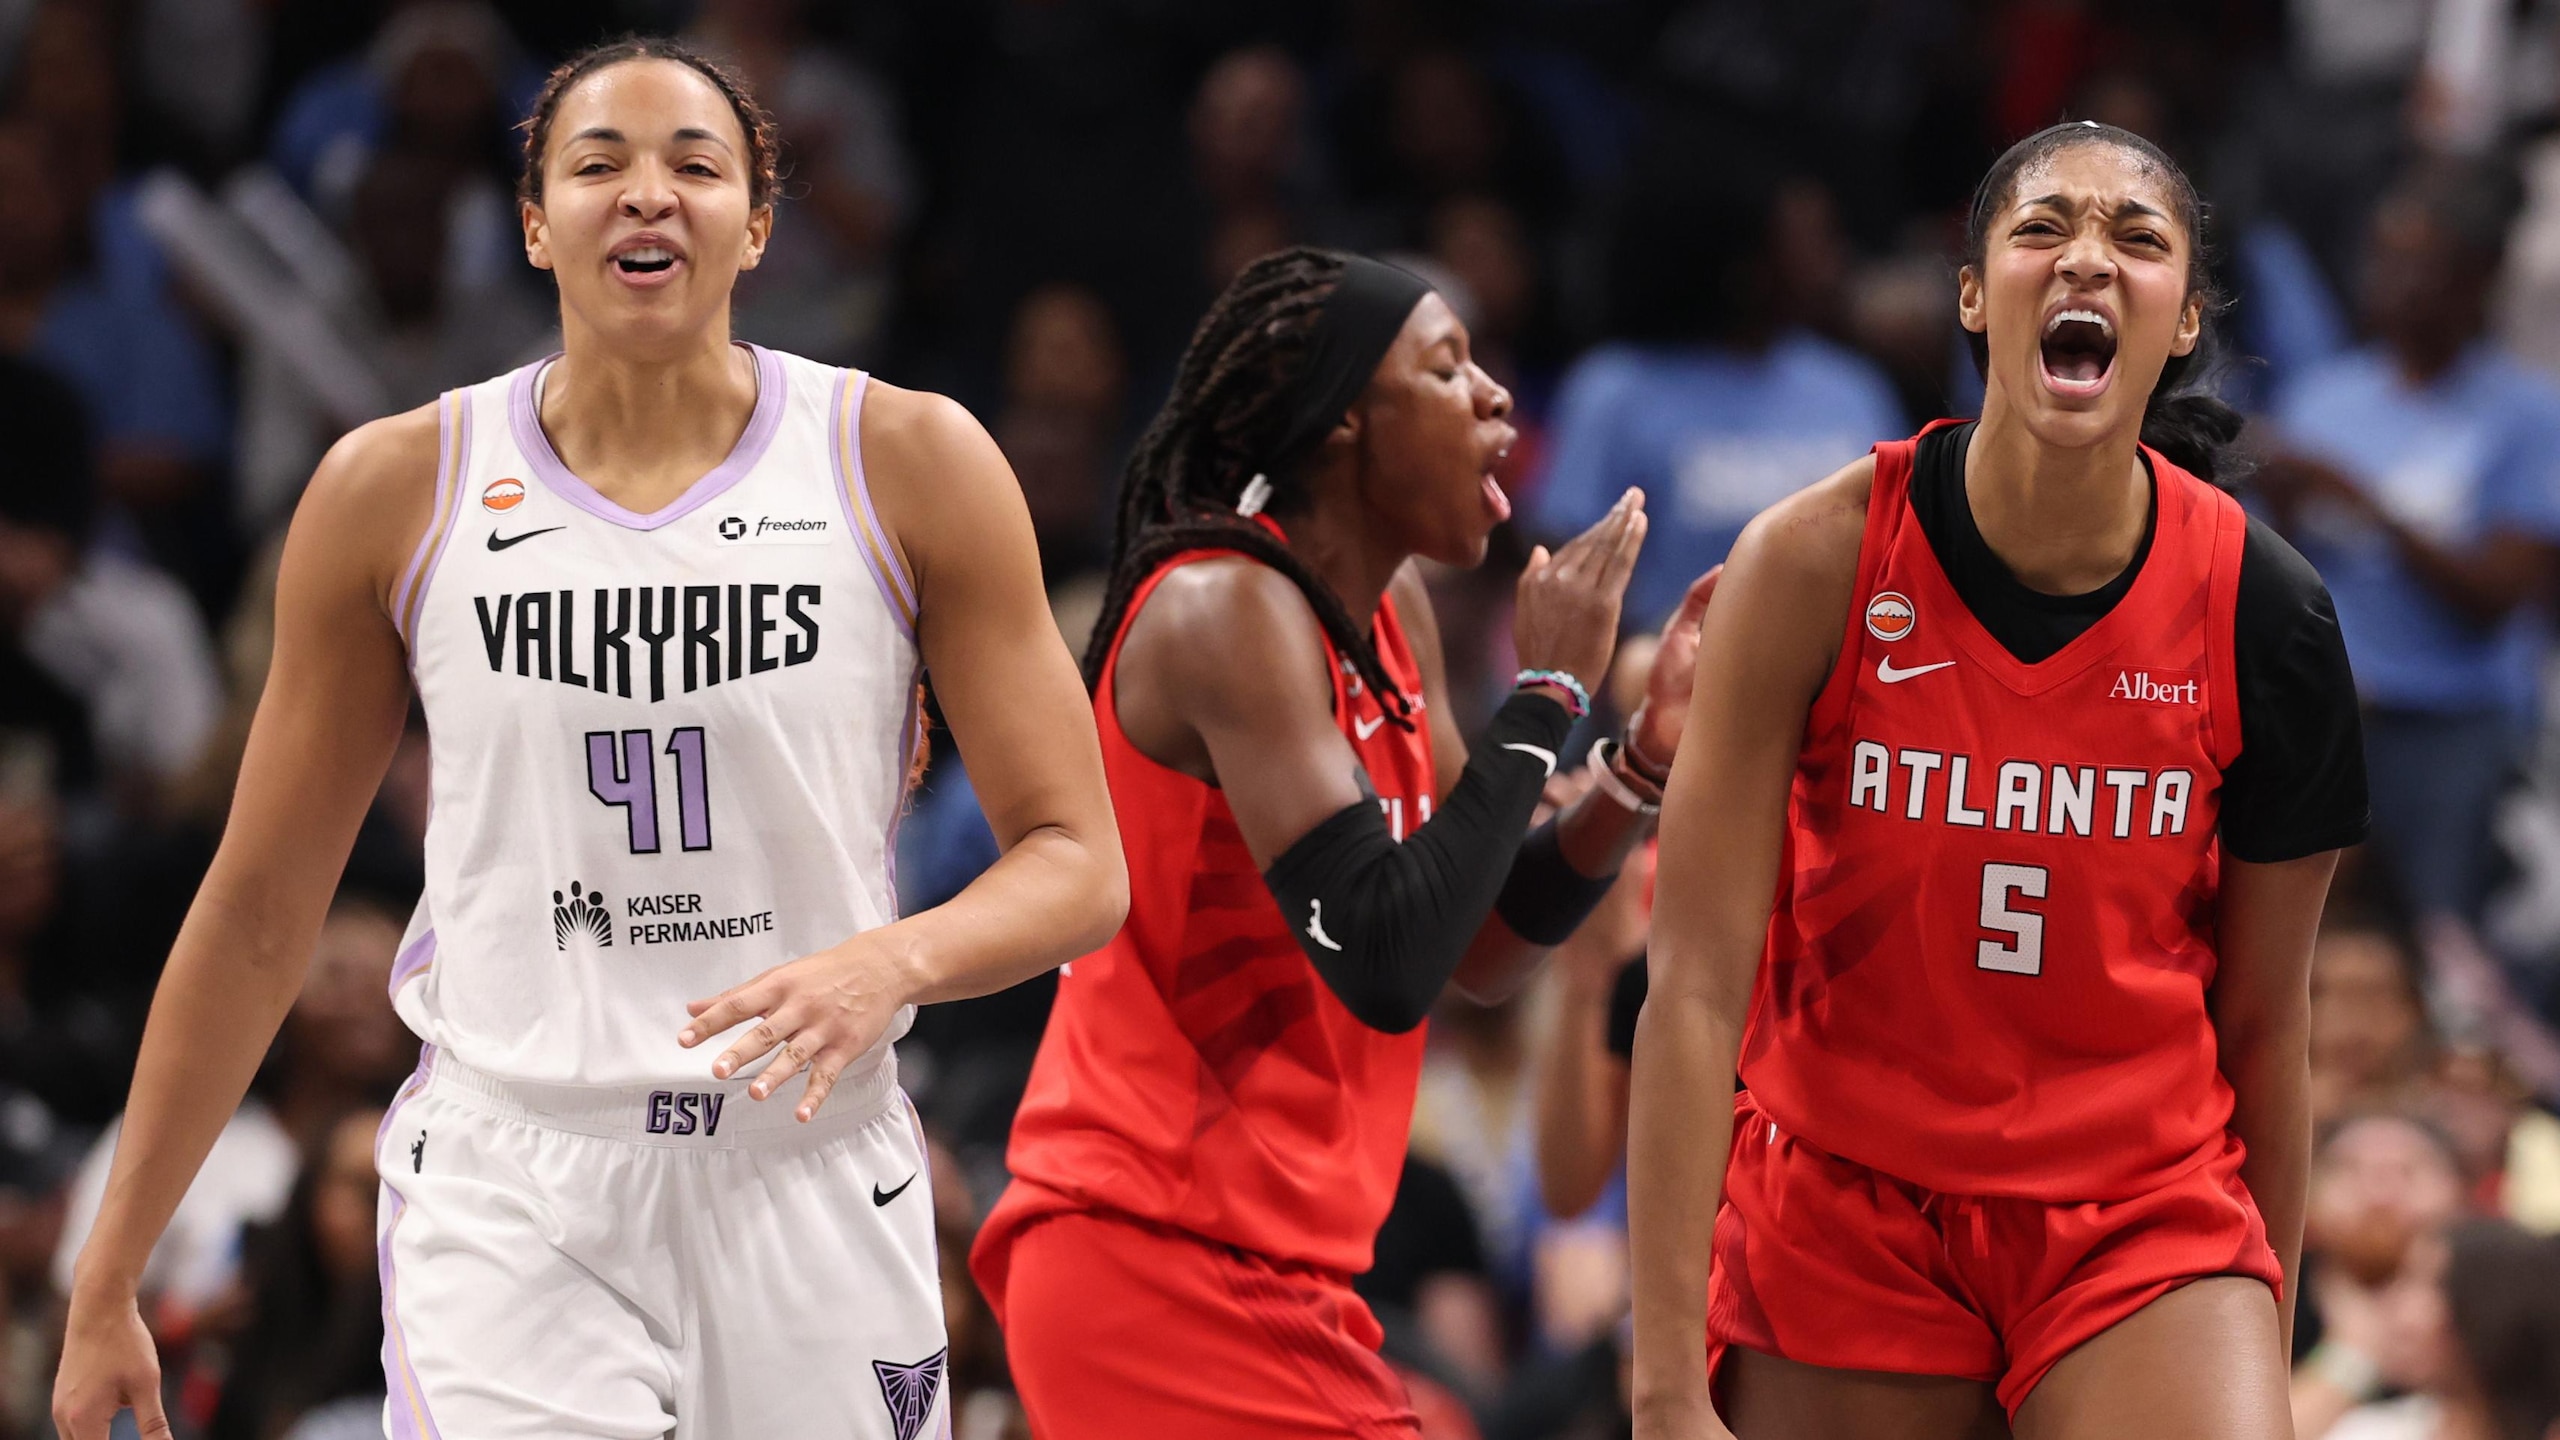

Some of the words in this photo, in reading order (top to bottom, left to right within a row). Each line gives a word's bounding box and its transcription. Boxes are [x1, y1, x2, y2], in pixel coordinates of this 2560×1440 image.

[756, 516, 827, 537] freedom
[474, 583, 821, 703] VALKYRIES
[2109, 670, 2198, 704] Albert
[585, 726, 712, 855] 41
[1850, 739, 2194, 838] ATLANTA
[627, 893, 703, 918] KAISER
[628, 910, 774, 946] PERMANENTE
[1976, 861, 2048, 976] 5
[645, 1090, 725, 1137] GSV
